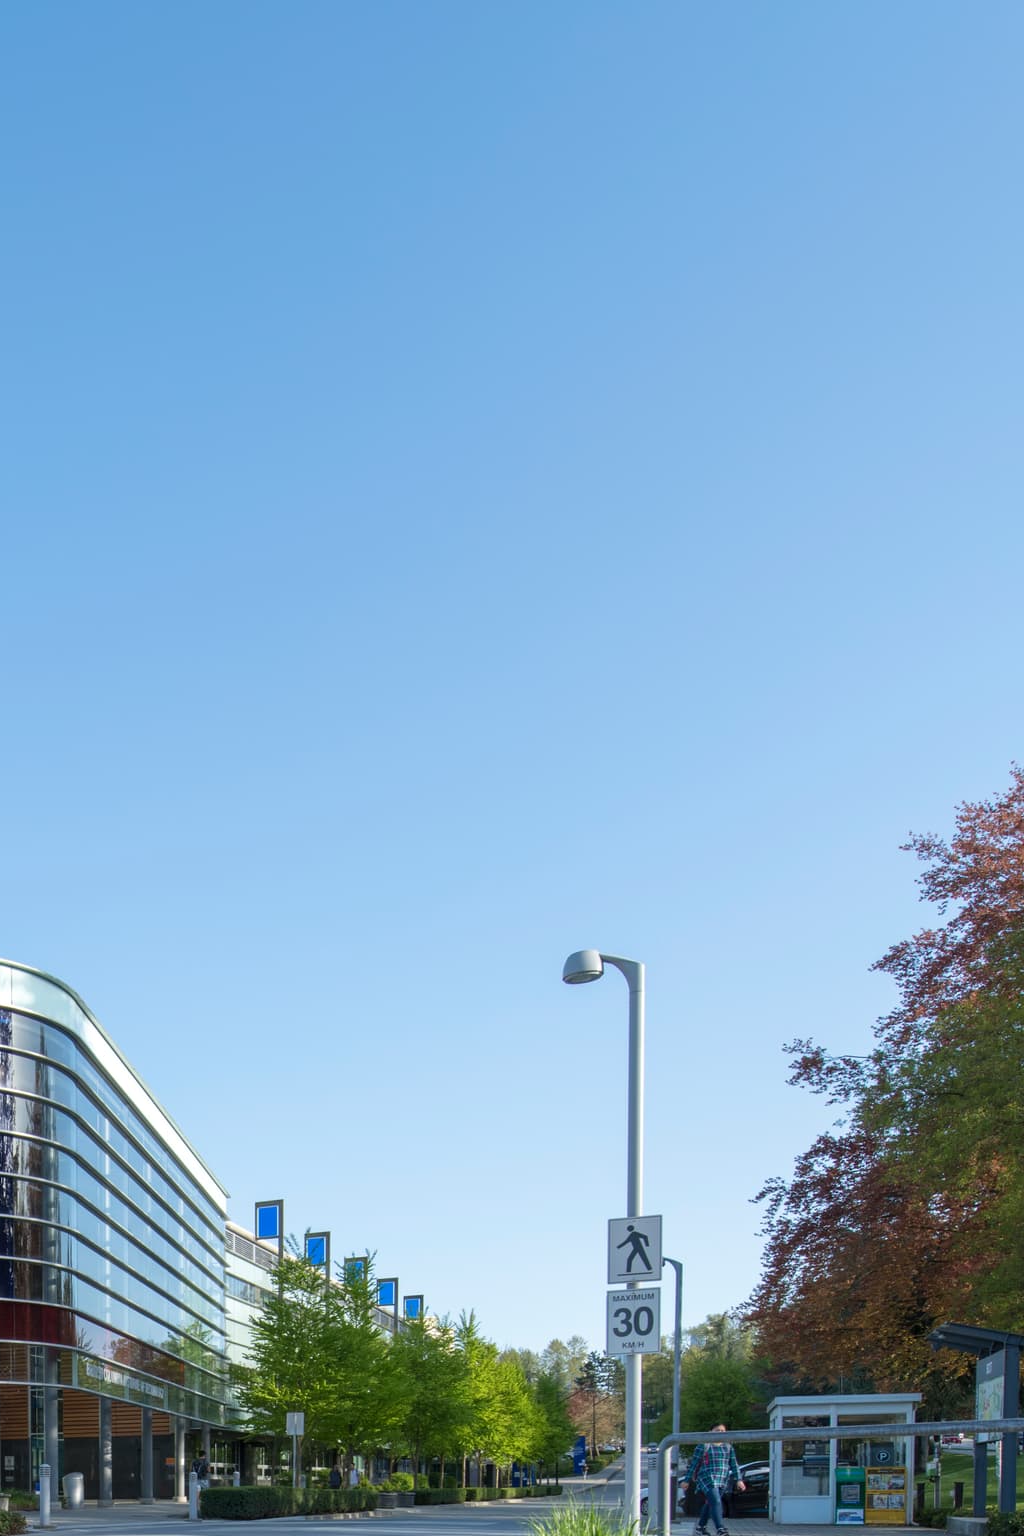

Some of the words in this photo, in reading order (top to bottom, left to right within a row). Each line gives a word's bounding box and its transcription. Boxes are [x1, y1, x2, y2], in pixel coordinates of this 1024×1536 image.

[612, 1293, 655, 1302] MAXIMUM
[613, 1306, 654, 1337] 30
[879, 1452, 888, 1461] P
